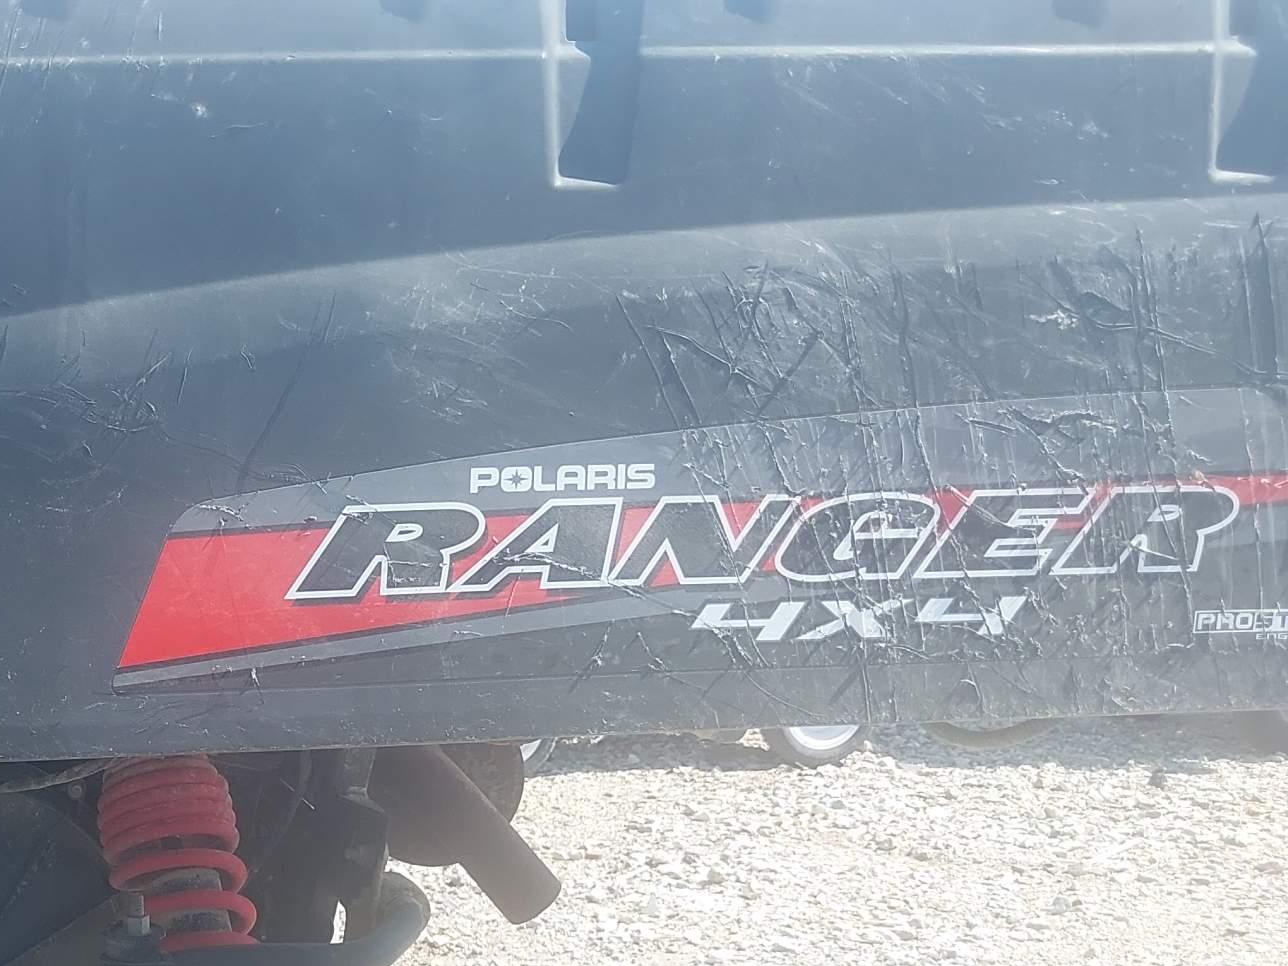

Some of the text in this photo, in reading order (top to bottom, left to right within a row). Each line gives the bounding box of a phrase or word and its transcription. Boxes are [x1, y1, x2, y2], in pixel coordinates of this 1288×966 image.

[469, 463, 657, 493] POLARIS
[284, 485, 1241, 599] RANGER
[690, 596, 1027, 641] 4X4
